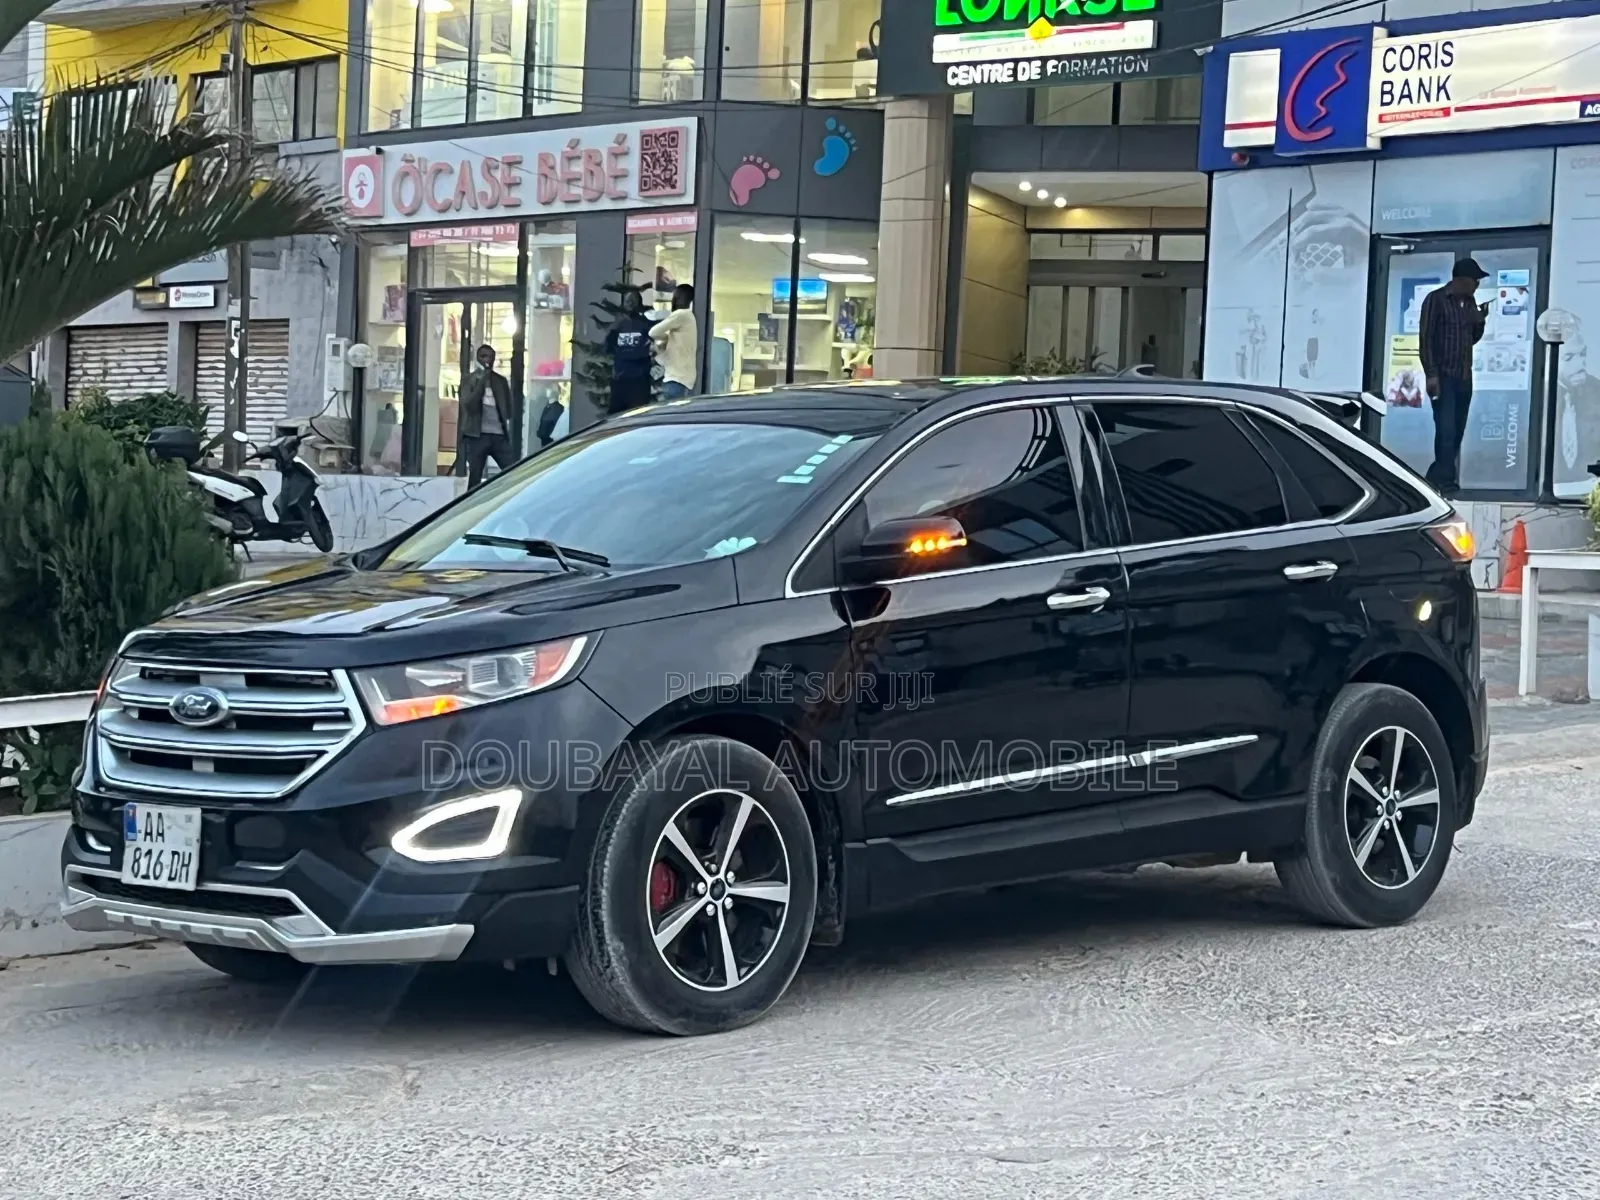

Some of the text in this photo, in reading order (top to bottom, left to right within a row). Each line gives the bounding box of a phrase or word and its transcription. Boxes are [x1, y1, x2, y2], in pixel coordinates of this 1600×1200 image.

[946, 54, 1149, 86] CENTRE DE FORMATION
[1382, 41, 1454, 73] CORIS
[1380, 74, 1452, 107] BANK
[537, 133, 629, 206] BÉBÉ
[1505, 403, 1520, 468] WELCOME
[143, 811, 165, 843] AA
[131, 847, 192, 883] 816 DH
